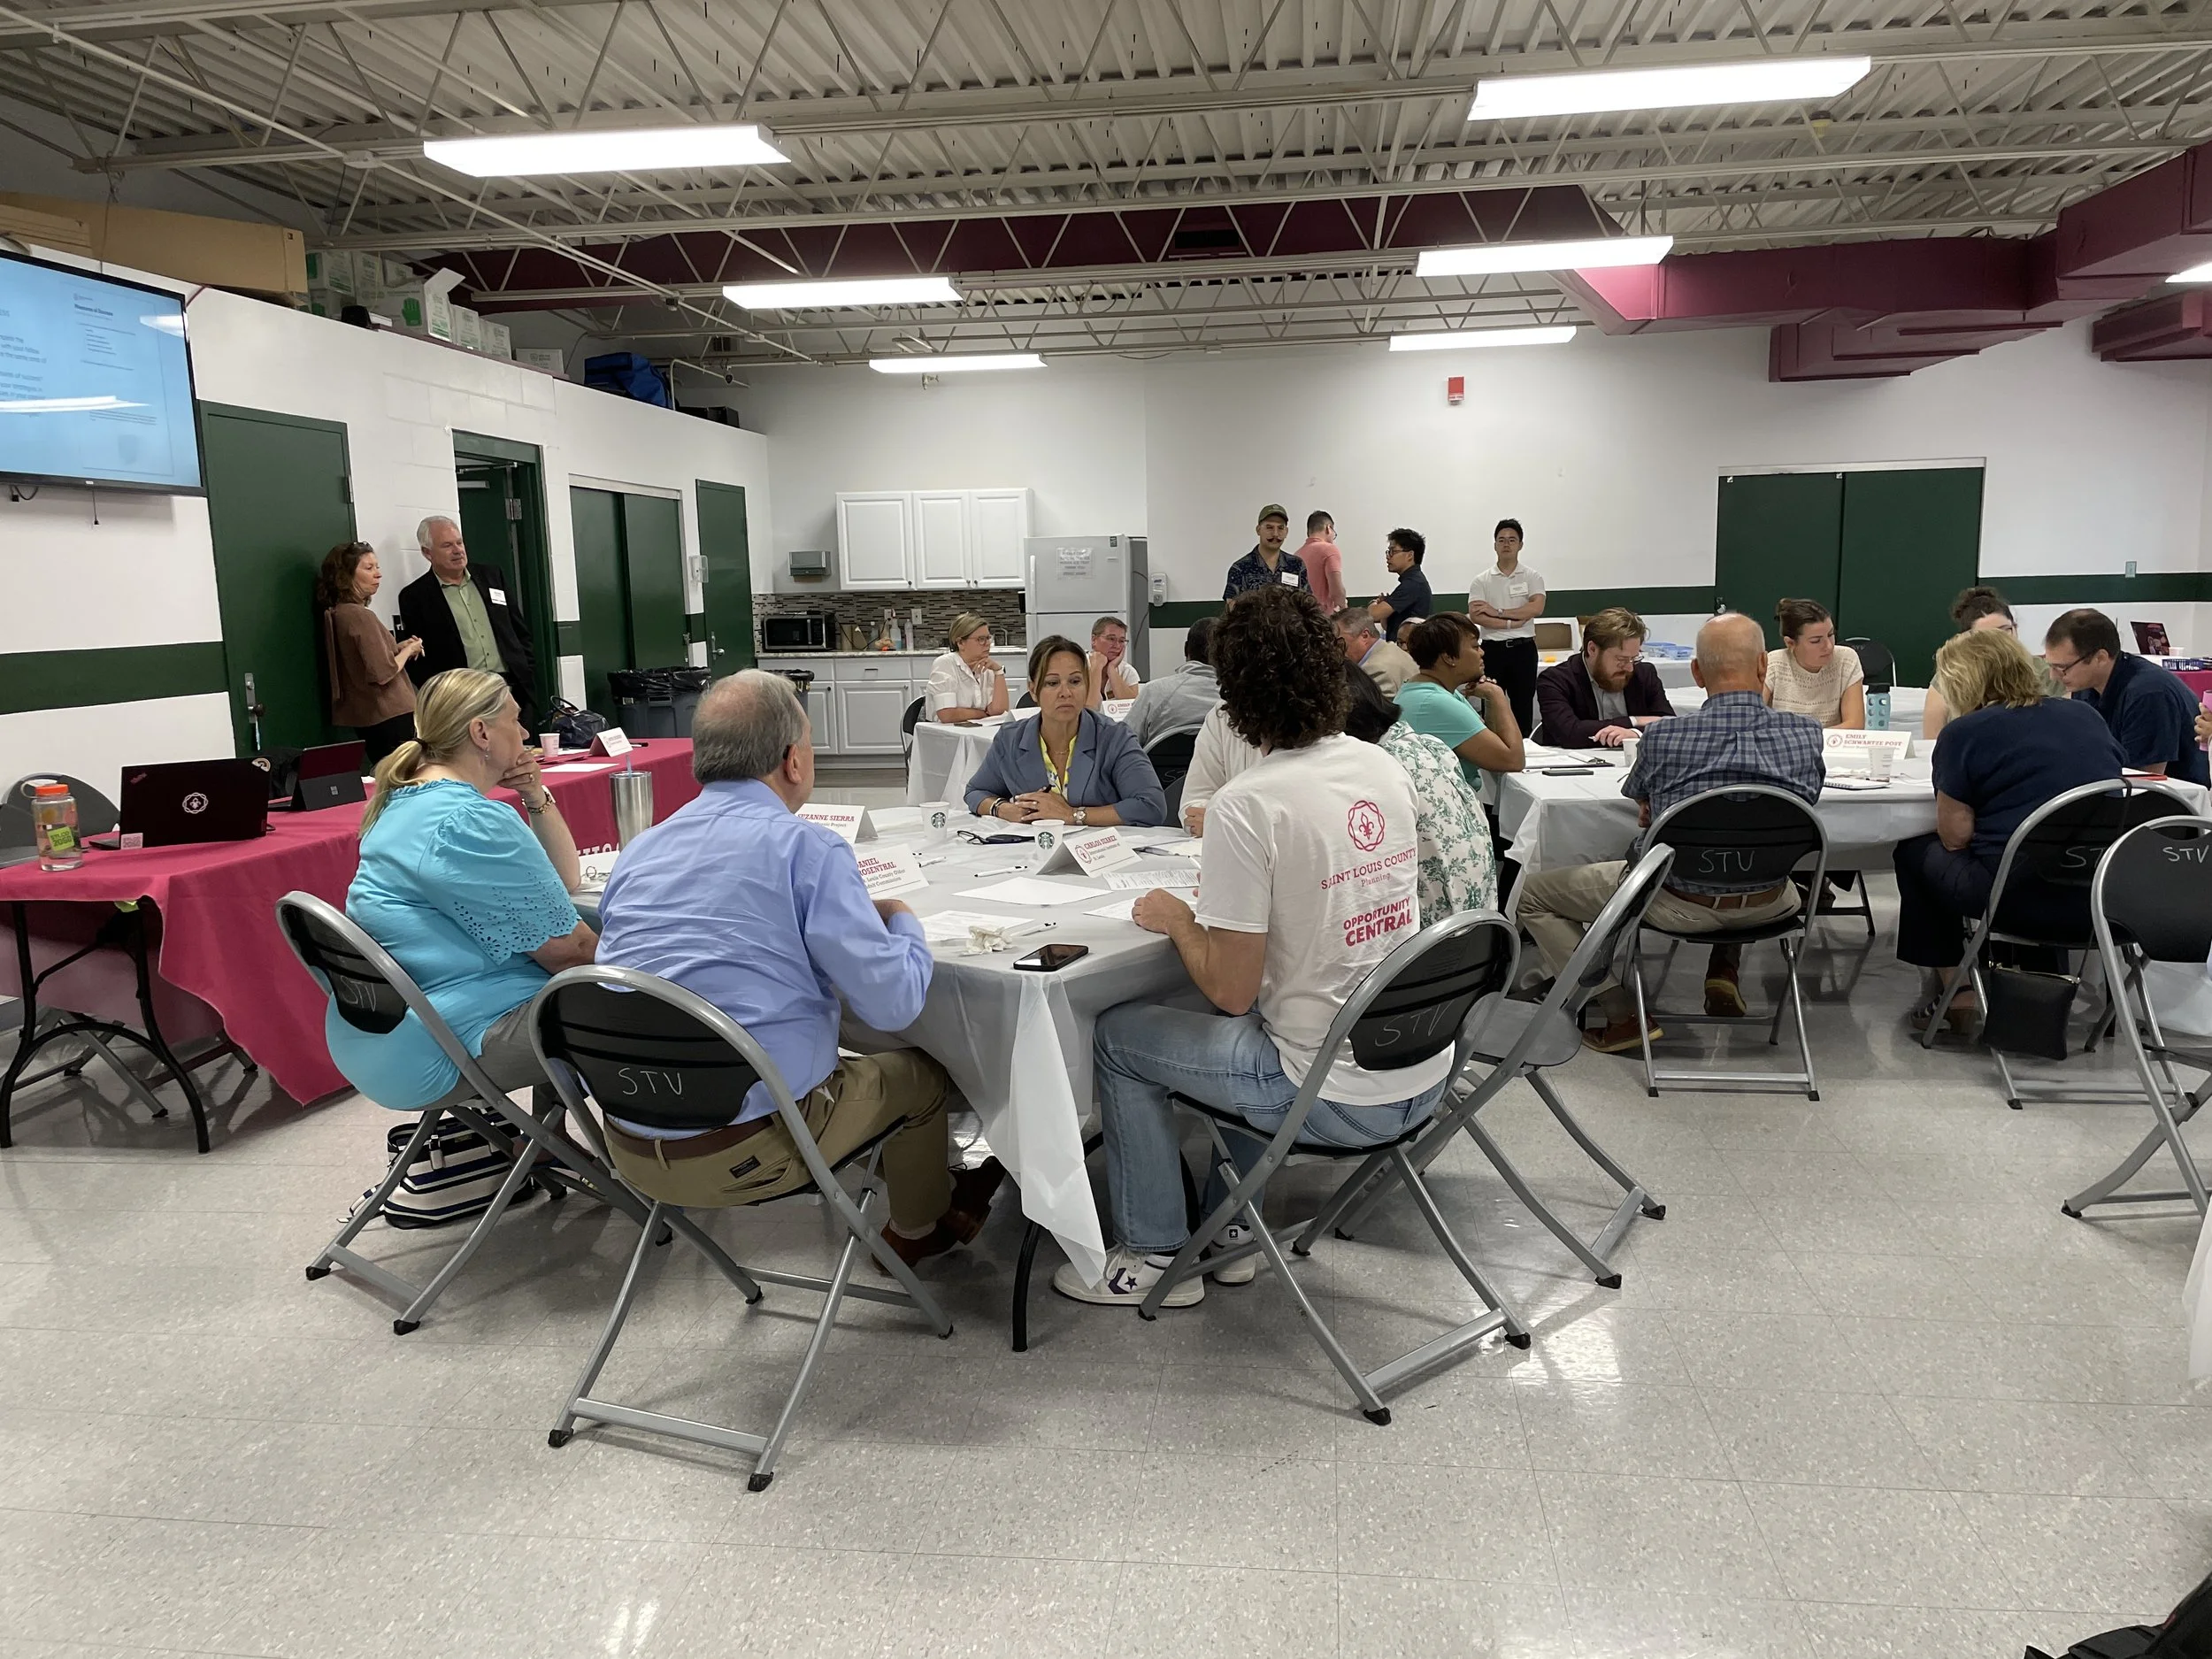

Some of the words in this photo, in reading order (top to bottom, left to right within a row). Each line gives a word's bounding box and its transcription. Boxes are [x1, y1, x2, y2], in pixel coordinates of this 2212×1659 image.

[1084, 840, 1102, 849] CARLOS
[856, 857, 879, 868] ANIEL
[1321, 870, 1351, 890] SAINT
[1354, 861, 1382, 878] LOUIS
[1384, 847, 1417, 868] COUNTY
[2060, 846, 2106, 869] ST
[1361, 872, 1391, 887] Planning
[1343, 896, 1411, 930] OPPORTUNITY
[1345, 909, 1413, 947] CENTRAL
